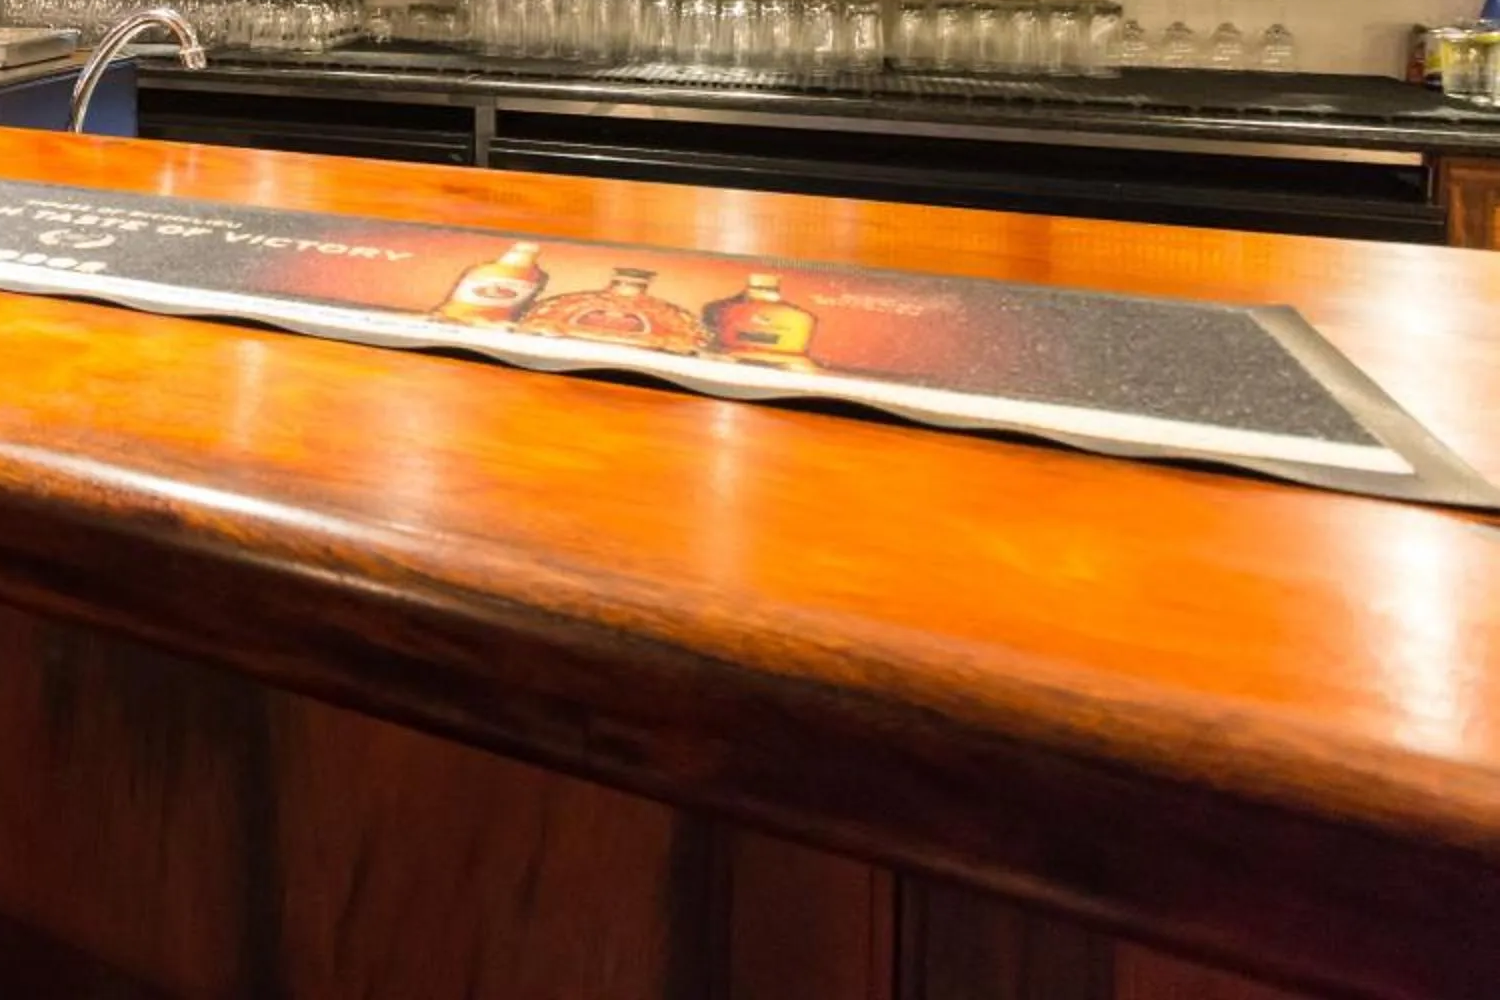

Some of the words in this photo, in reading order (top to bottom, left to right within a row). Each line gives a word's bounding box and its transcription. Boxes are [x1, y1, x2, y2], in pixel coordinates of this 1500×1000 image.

[32, 209, 150, 232] TASTE
[156, 223, 214, 238] OF
[225, 231, 414, 262] VICTORY
